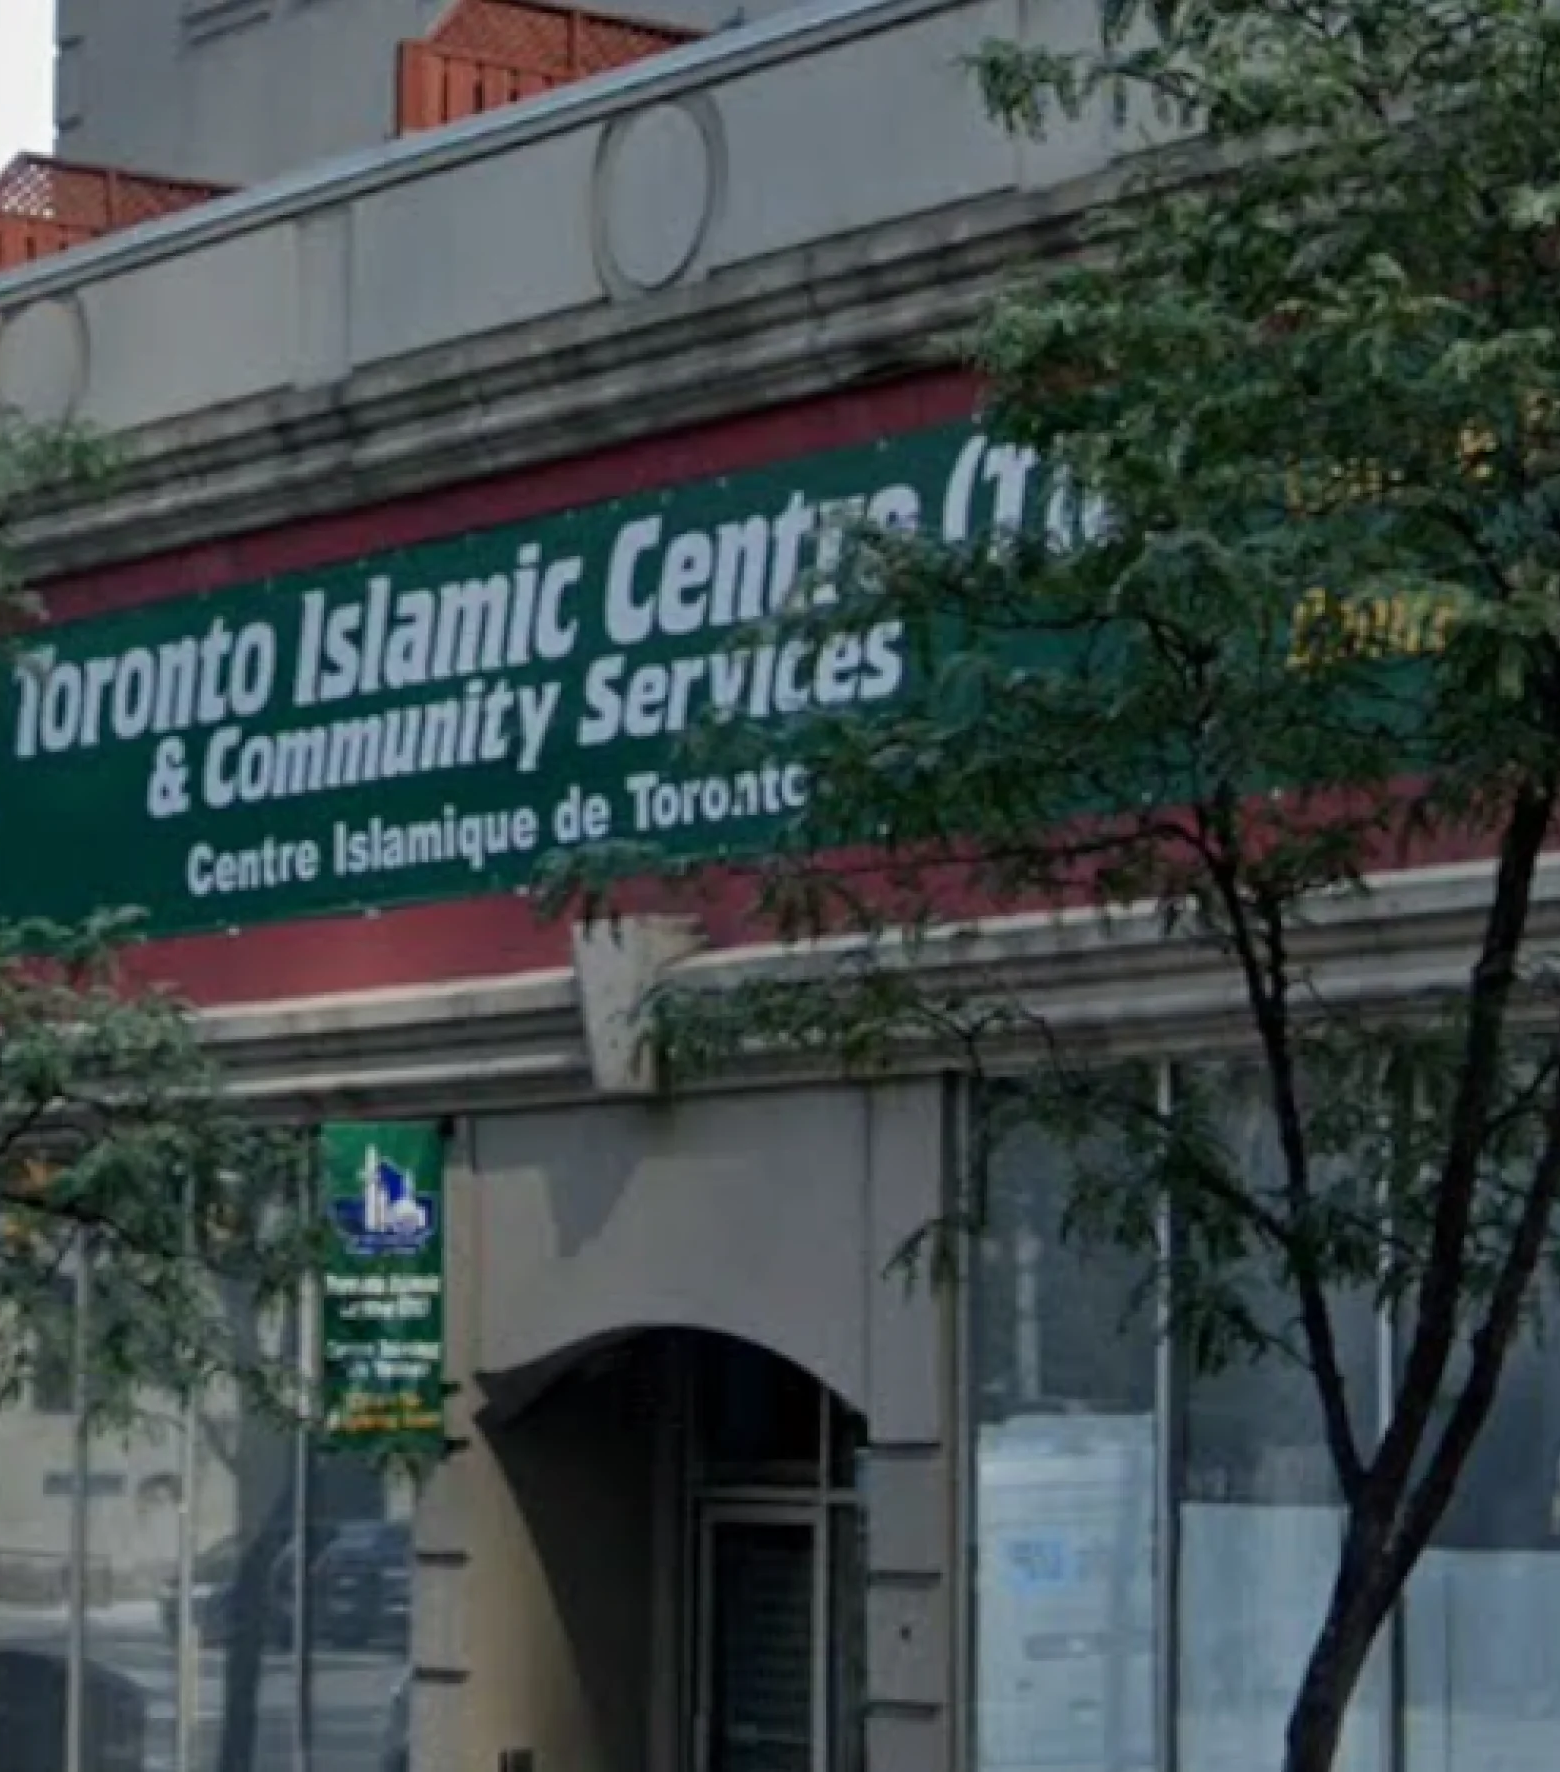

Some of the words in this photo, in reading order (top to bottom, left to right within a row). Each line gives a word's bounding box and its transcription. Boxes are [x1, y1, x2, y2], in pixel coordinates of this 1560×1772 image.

[14, 617, 276, 757] Toronto
[294, 543, 583, 705] Islamic
[147, 736, 190, 818] &
[203, 680, 561, 808] Community
[578, 619, 905, 746] Services
[187, 838, 319, 896] Centre
[334, 805, 539, 876] Islamique
[553, 783, 611, 844] de
